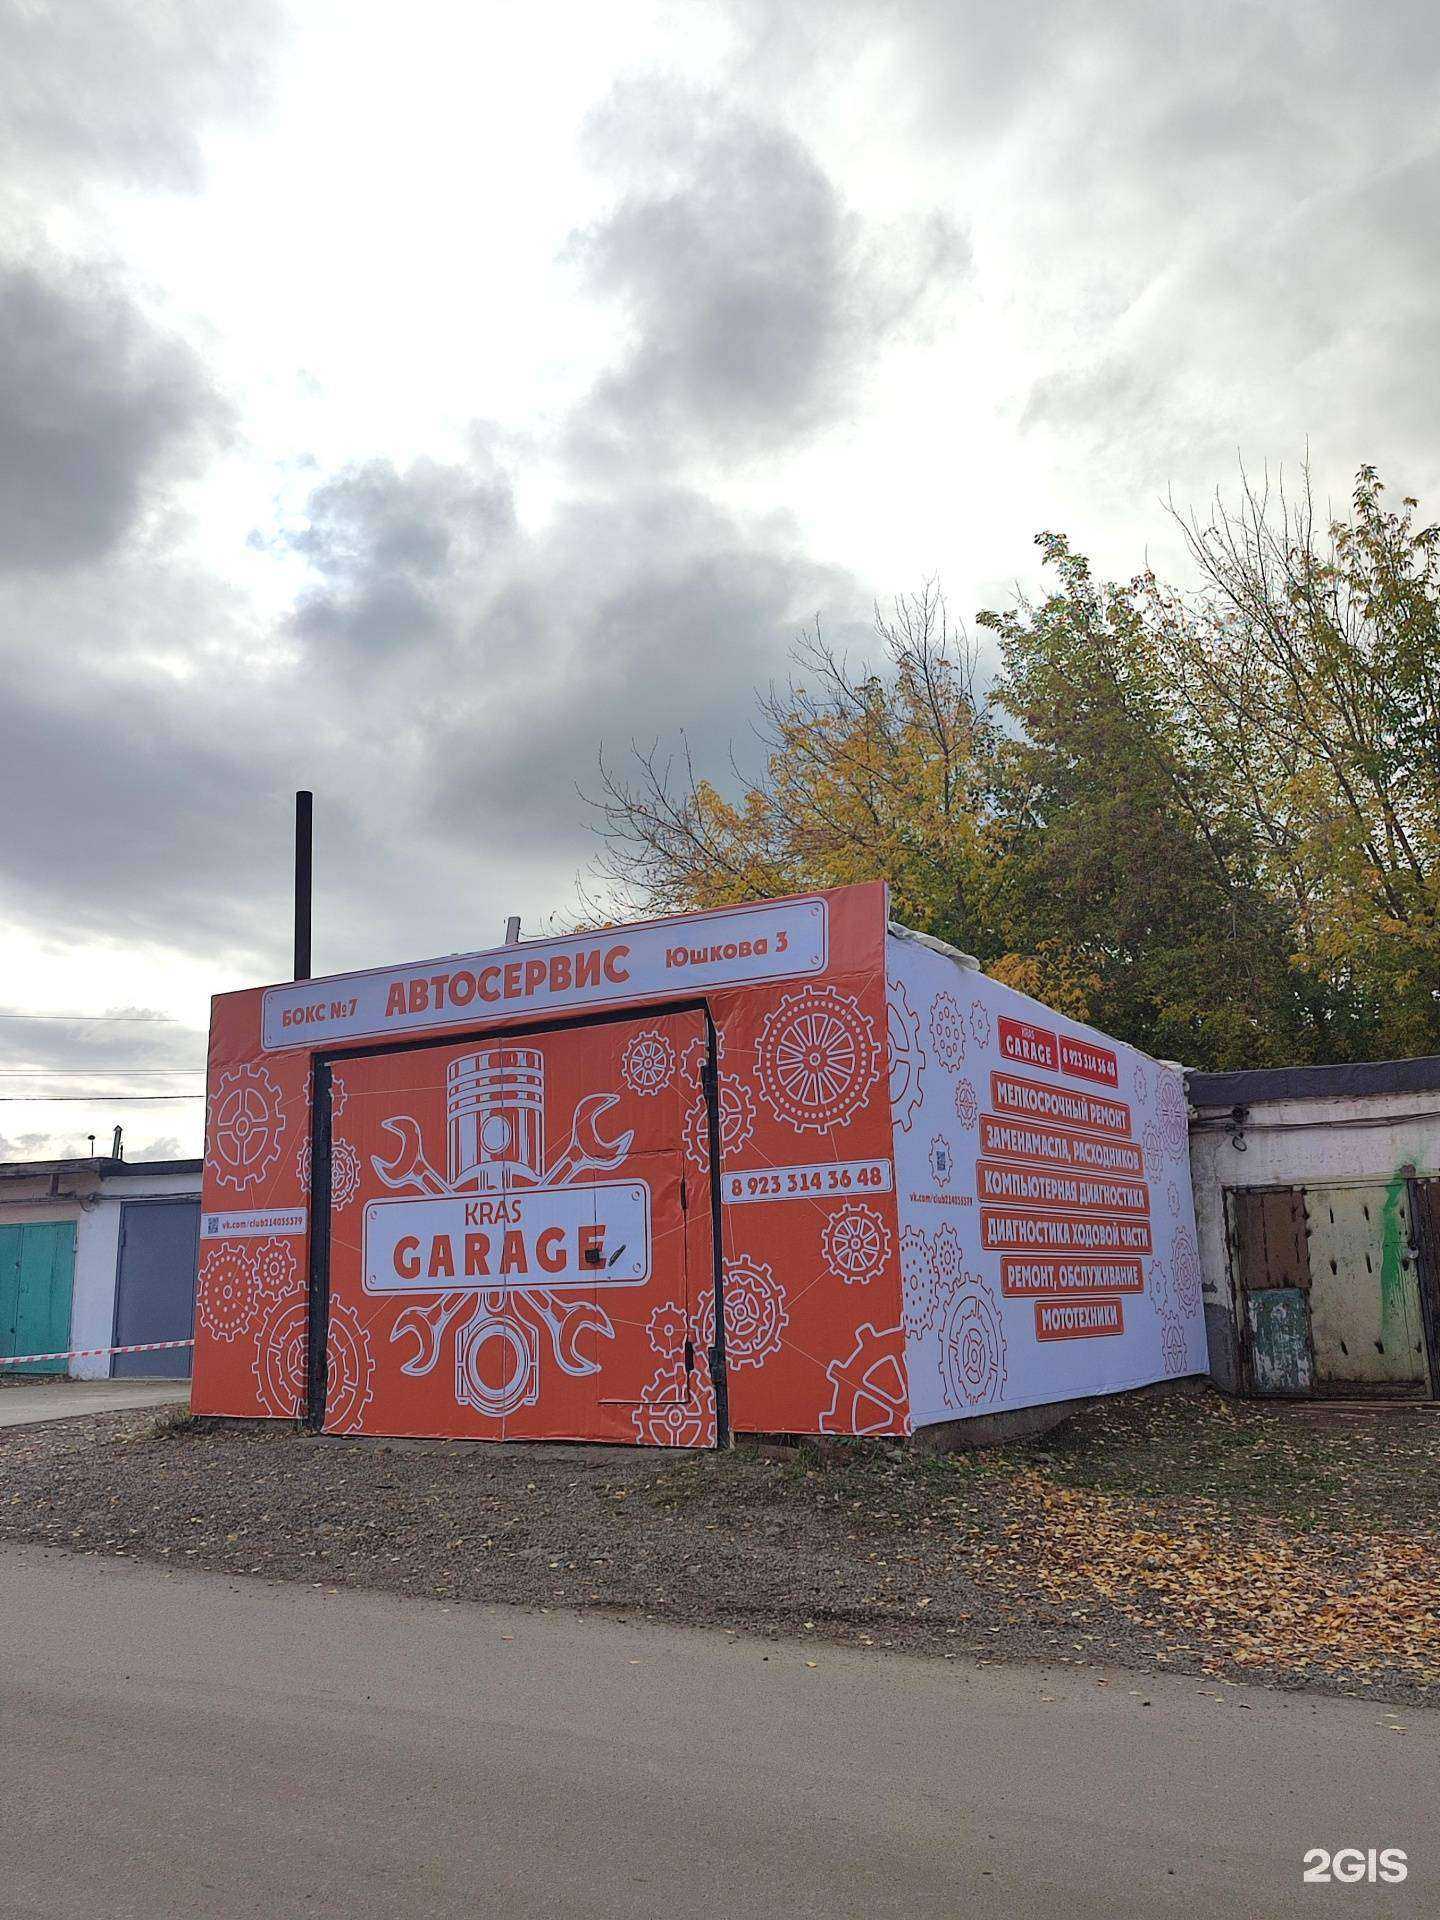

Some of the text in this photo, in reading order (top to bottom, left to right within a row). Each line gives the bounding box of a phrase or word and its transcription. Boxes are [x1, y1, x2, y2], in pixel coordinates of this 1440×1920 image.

[282, 931, 788, 1027] БОКС №7 АВТОСЕРВИС Юшкова 3
[1006, 1035, 1052, 1065] GARAGE
[1062, 1047, 1116, 1077] 8 923 314 36 48
[997, 1081, 1126, 1130] МЕЛКОСРОЧНЫЙ РЕМОНТ
[1073, 1141, 1139, 1170] РАСХОДНИКОВ
[731, 1166, 882, 1197] 8 923 314 36 48
[984, 1170, 1145, 1208] КОМПЬЮТЕРНАЯ ДИАГНОСТИКА
[465, 1200, 521, 1226] KRAS
[988, 1218, 1148, 1247] ДИАГНОСТИКА ХОДОВОЙ ЧАСТИ
[393, 1224, 606, 1279] GARAGE
[1007, 1265, 1139, 1291] РЕМОНТ, ОБСЛУЖИВАНИЕ
[1041, 1305, 1118, 1331] МОТОТЕХНИКИ
